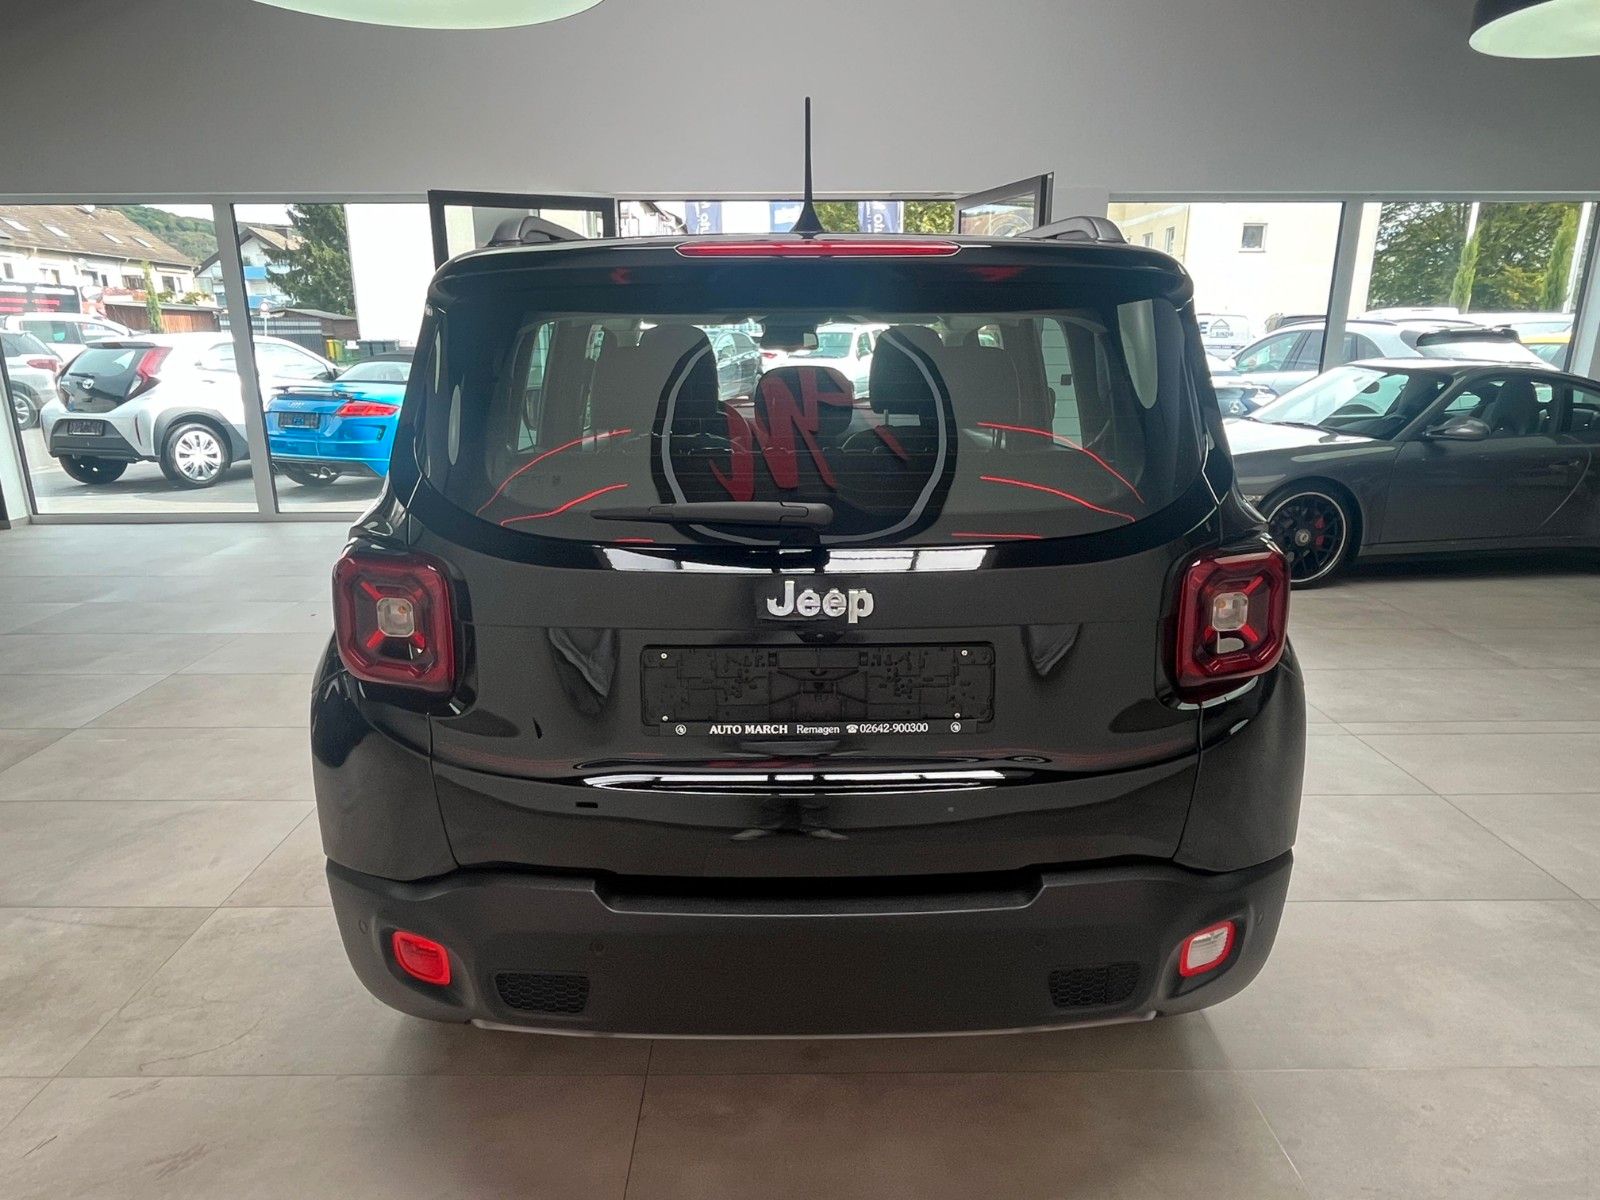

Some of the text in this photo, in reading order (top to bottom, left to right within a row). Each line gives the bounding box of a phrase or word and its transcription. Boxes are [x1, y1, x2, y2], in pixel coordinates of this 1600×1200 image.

[767, 581, 874, 624] Jeep
[709, 722, 929, 735] AUTO MARCH Remagen 02642-900300
